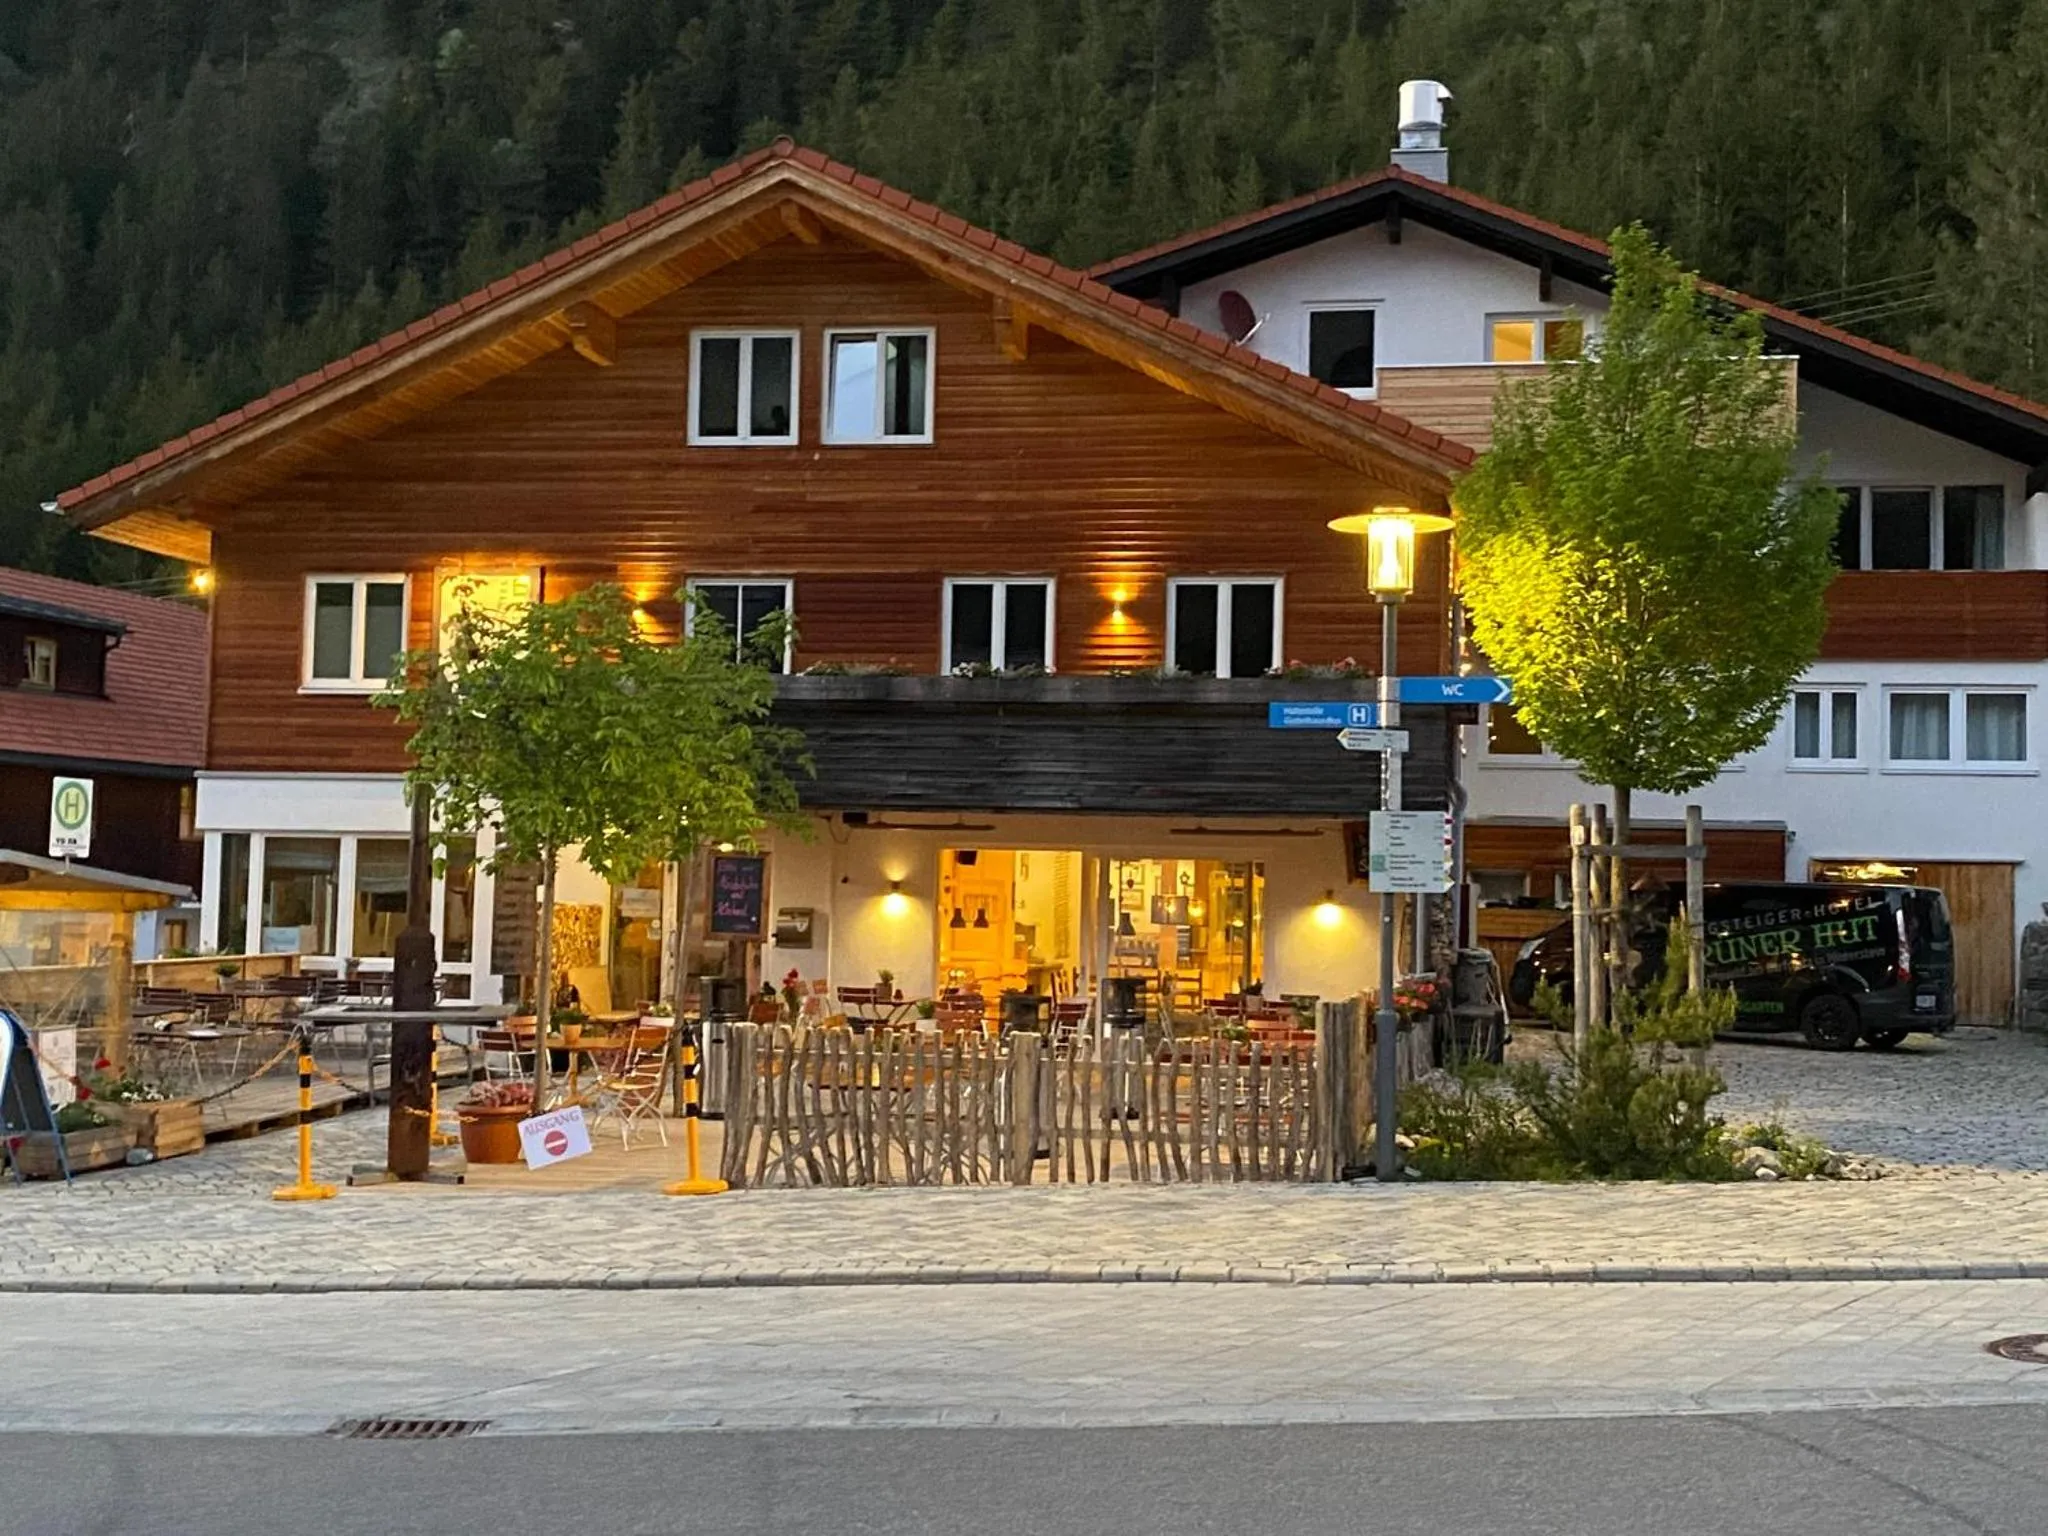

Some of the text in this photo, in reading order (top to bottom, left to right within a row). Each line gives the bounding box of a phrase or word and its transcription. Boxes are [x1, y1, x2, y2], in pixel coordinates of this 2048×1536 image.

[1442, 684, 1464, 696] WC
[64, 791, 80, 820] H
[1811, 915, 1880, 948] HUT
